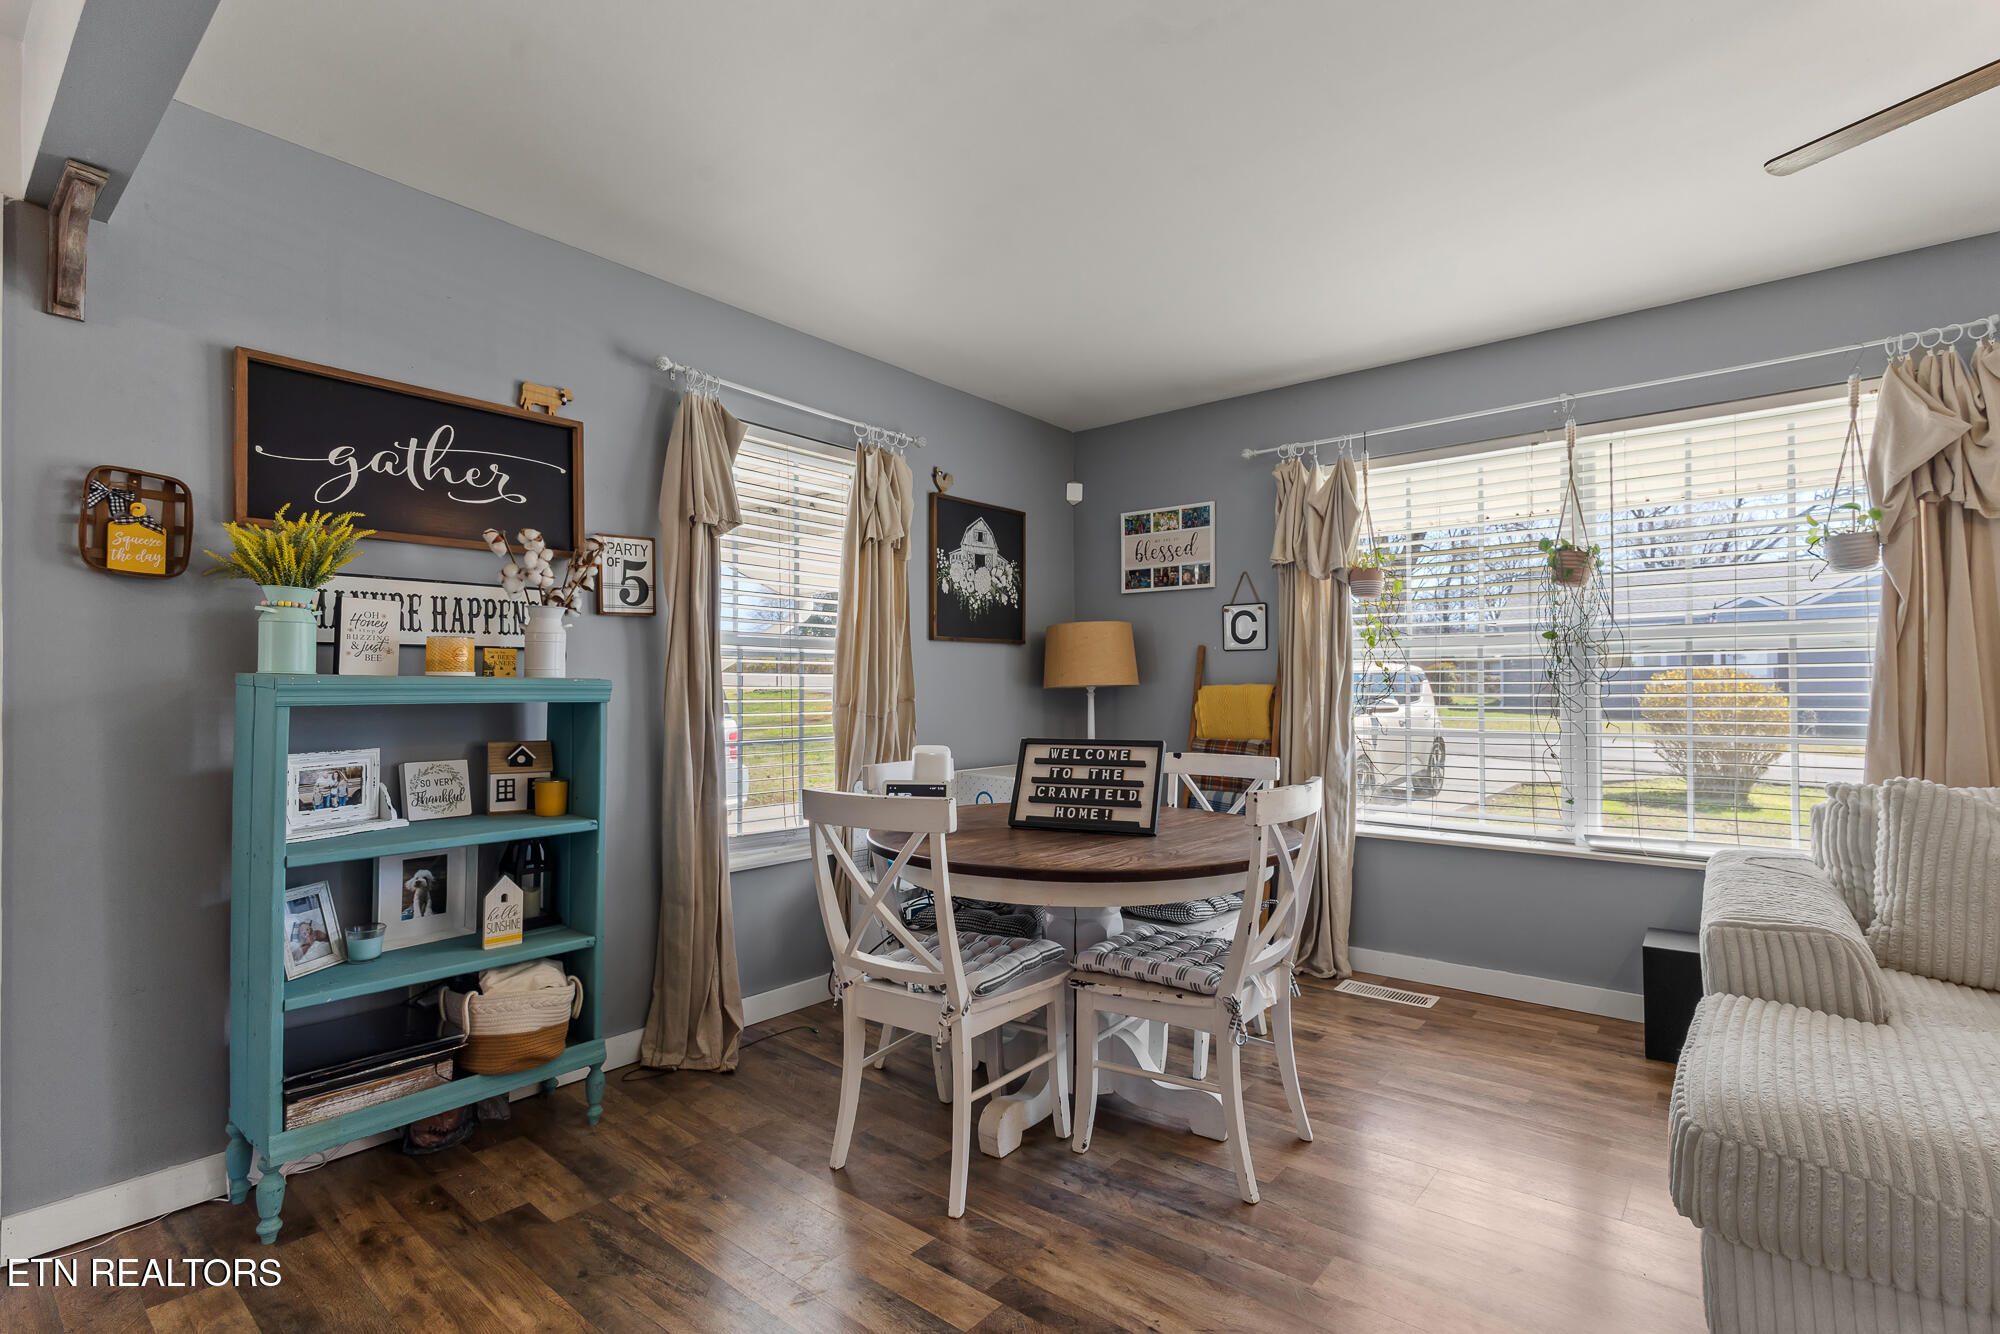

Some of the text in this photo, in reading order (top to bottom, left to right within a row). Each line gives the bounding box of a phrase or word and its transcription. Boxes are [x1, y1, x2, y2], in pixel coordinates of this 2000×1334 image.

[255, 424, 565, 503] gather
[111, 531, 163, 550] Squeeze
[606, 541, 649, 557] PARTY
[1134, 531, 1199, 562] blessed
[111, 549, 163, 567] the day
[606, 556, 621, 567] OF
[619, 559, 650, 607] 5
[350, 612, 389, 634] Honey
[363, 610, 380, 619] OH
[430, 594, 539, 636] HAPPEN
[1230, 609, 1258, 645] C
[346, 633, 390, 641] BUZZING
[350, 639, 390, 658] & just
[364, 653, 384, 662] BEE
[1050, 748, 1130, 761] WELCOME
[1051, 767, 1123, 780] TO THE
[420, 777, 455, 788] SO VERY
[411, 787, 466, 807] Thankful
[1037, 786, 1138, 801] CRANFIELD
[1055, 806, 1111, 820] HOME!
[487, 904, 519, 921] hello
[486, 917, 521, 935] SUNSHINE
